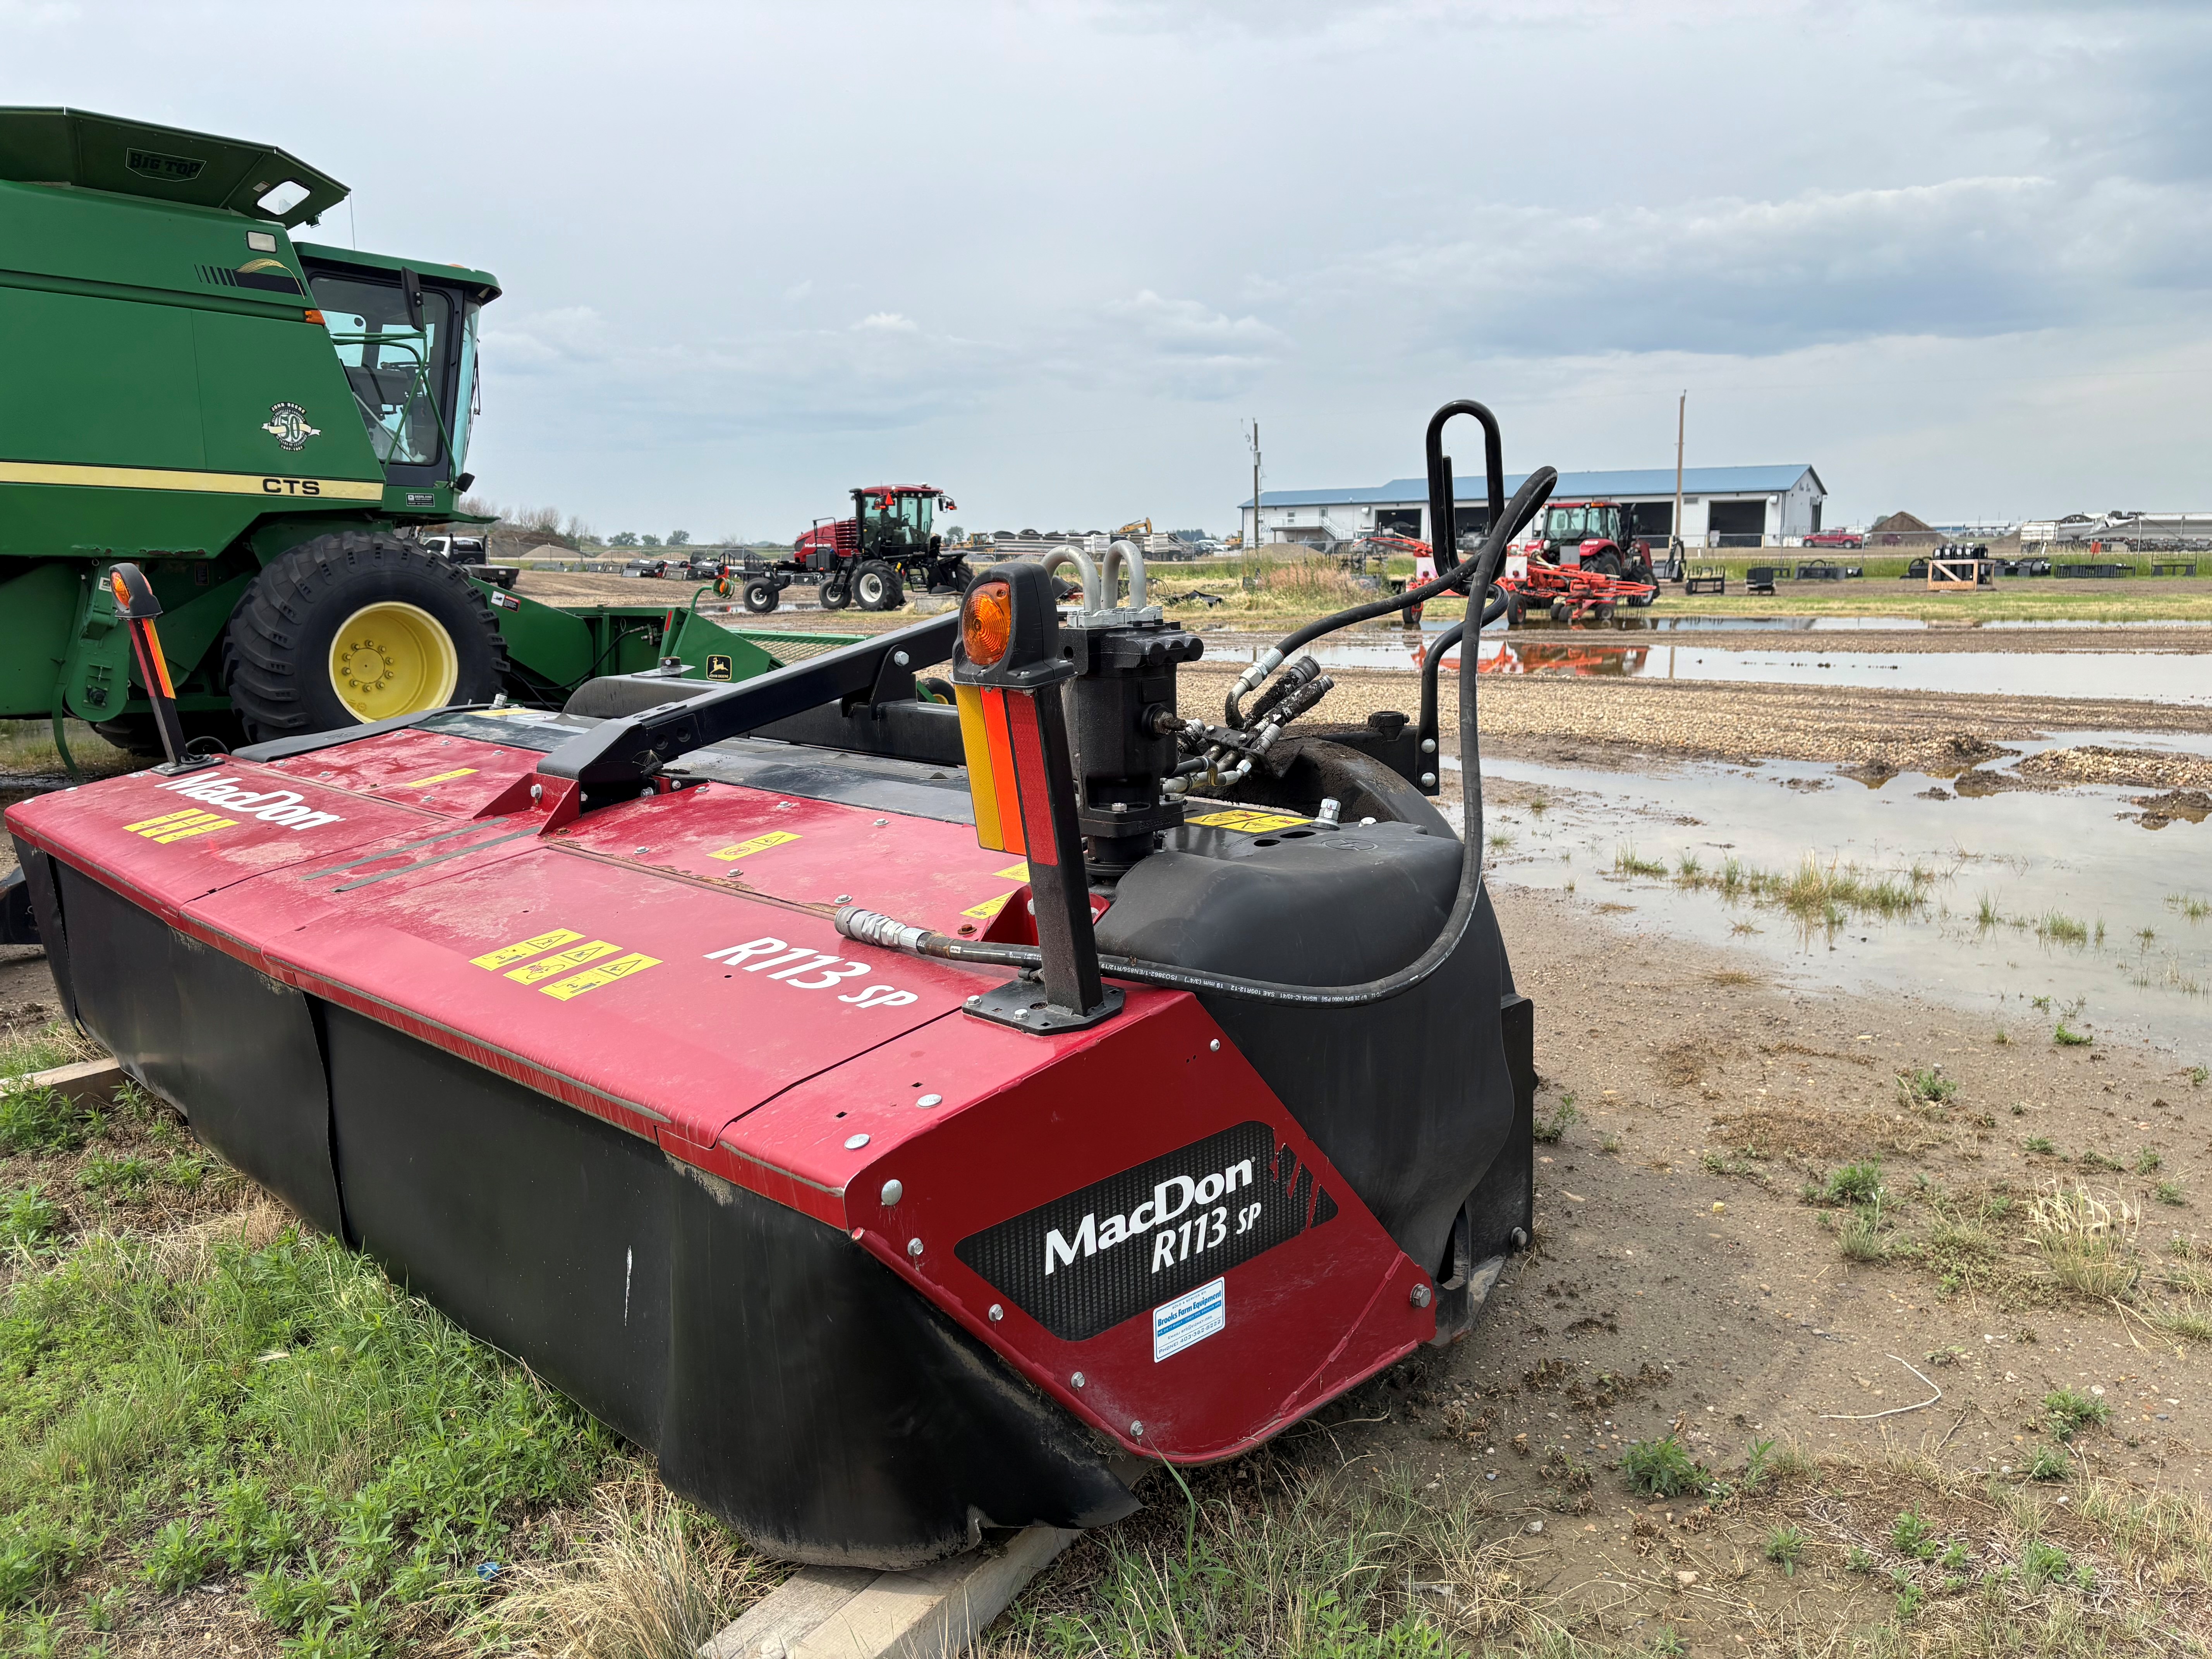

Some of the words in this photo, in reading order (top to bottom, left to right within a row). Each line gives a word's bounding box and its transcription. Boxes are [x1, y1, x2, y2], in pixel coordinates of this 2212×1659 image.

[130, 152, 161, 169] BIG
[165, 161, 201, 177] TOP
[280, 414, 300, 440] 50
[263, 479, 319, 495] CTS
[155, 772, 340, 830] MacDon
[702, 937, 872, 989] R113
[838, 985, 918, 1008] SP
[1231, 985, 1261, 995] 100R12-12
[1046, 1159, 1252, 1275] MacDon
[1152, 1206, 1227, 1274] R113
[1236, 1202, 1261, 1234] SP
[1158, 1312, 1177, 1327] Brooks
[1178, 1306, 1192, 1317] Farm
[1193, 1290, 1221, 1309] Equipment
[1159, 1341, 1178, 1354] PHONE:
